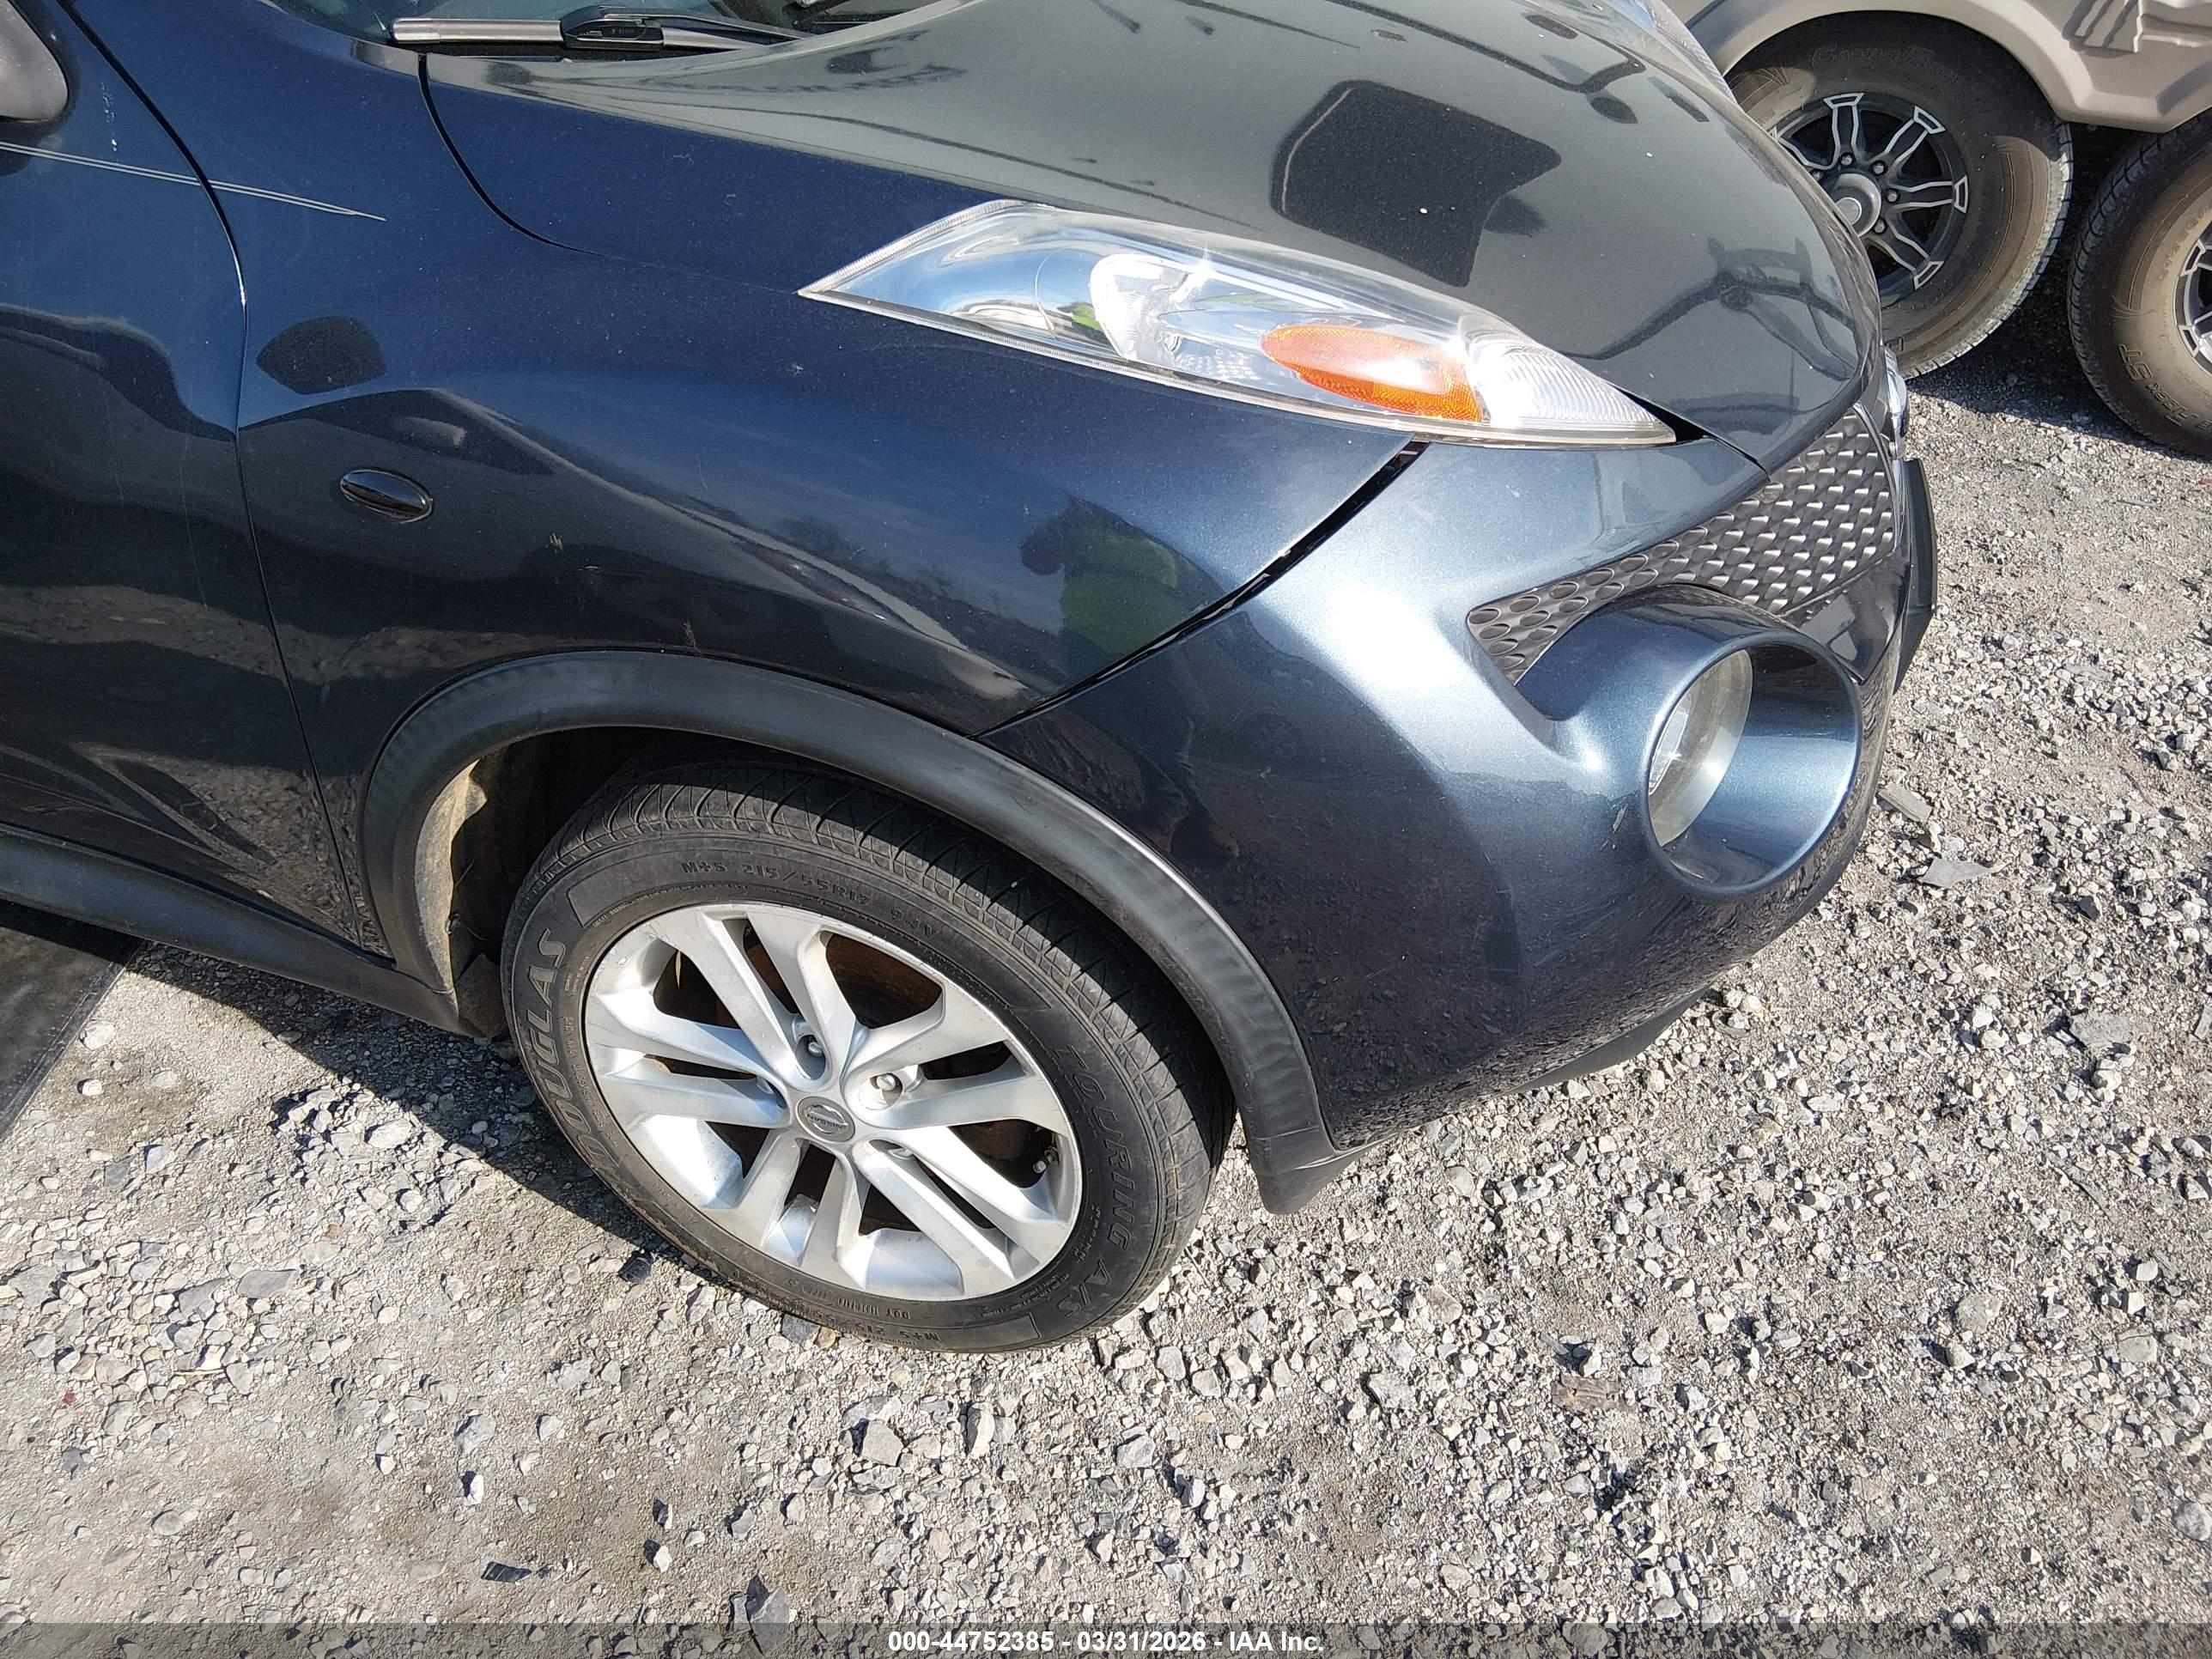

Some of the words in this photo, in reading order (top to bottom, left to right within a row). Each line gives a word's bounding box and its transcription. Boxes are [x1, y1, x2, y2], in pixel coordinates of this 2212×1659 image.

[527, 927, 620, 1176] DOUGLAS
[1053, 1043, 1136, 1250] TOURING
[1056, 1257, 1112, 1318] A/S
